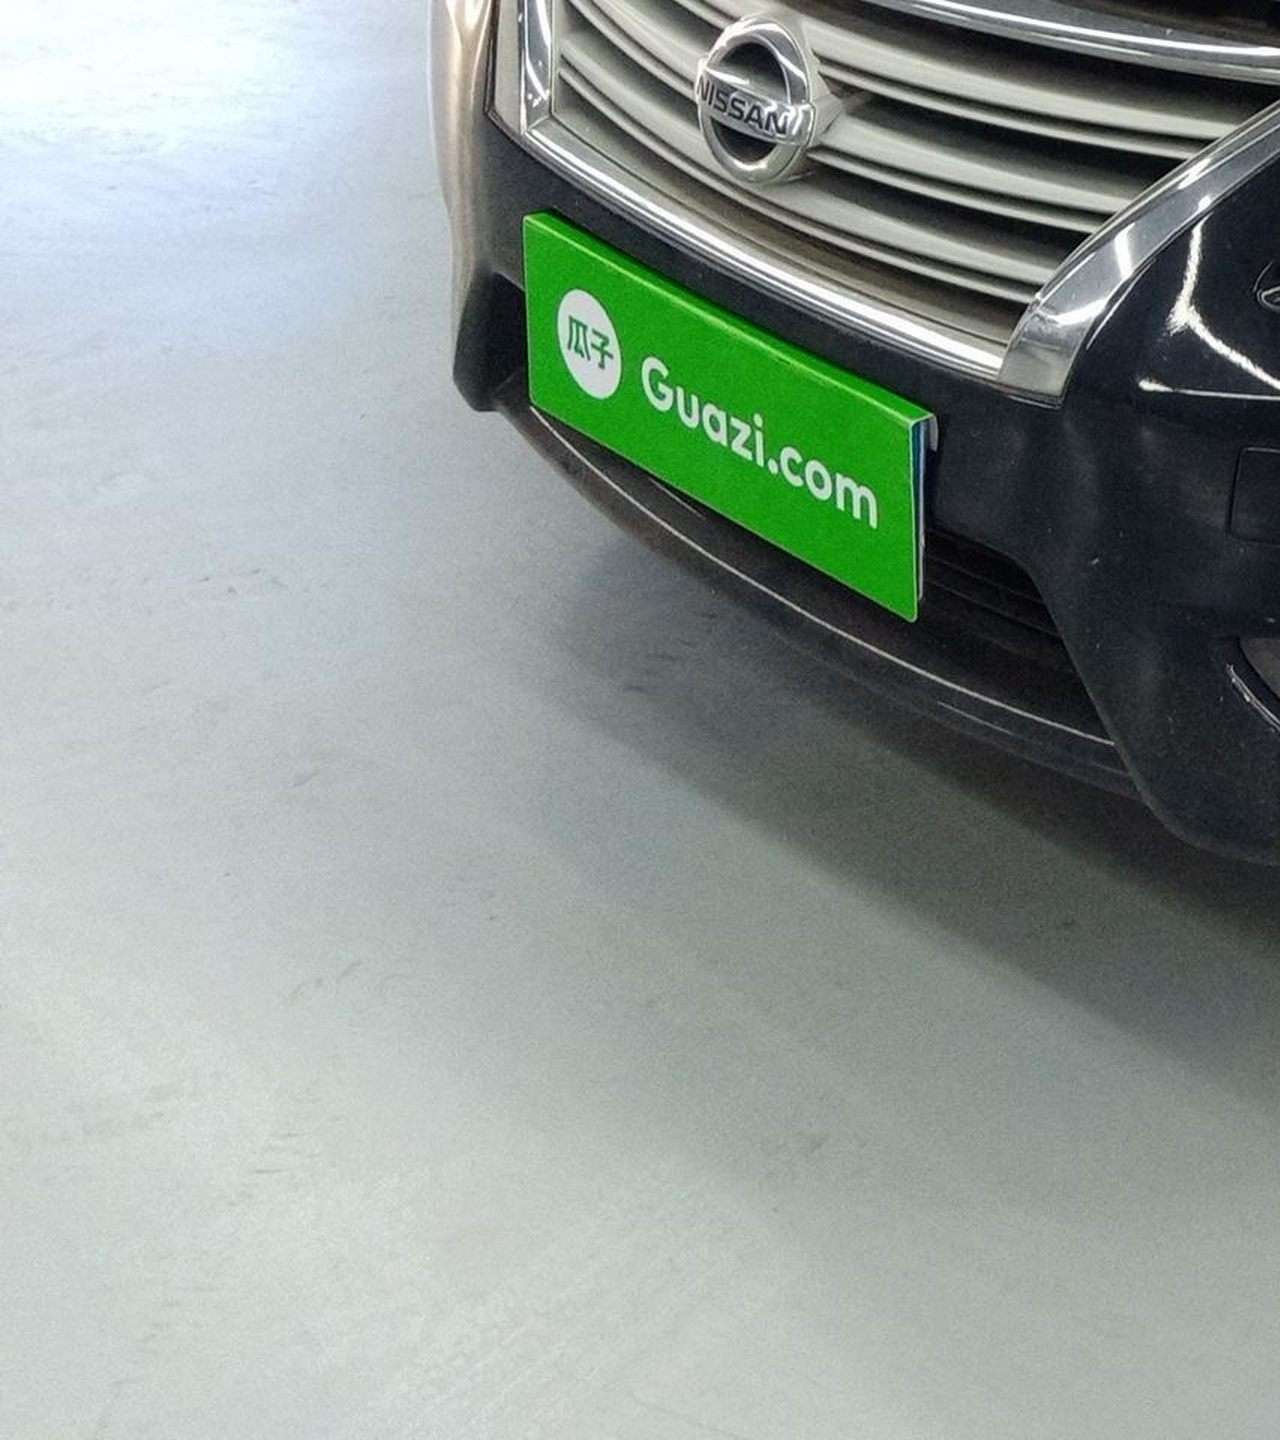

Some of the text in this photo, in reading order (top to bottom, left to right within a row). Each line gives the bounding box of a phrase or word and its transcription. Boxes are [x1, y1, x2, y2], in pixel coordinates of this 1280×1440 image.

[696, 74, 789, 136] NISSAN
[567, 315, 879, 529] 瓜子 Guazi.com
